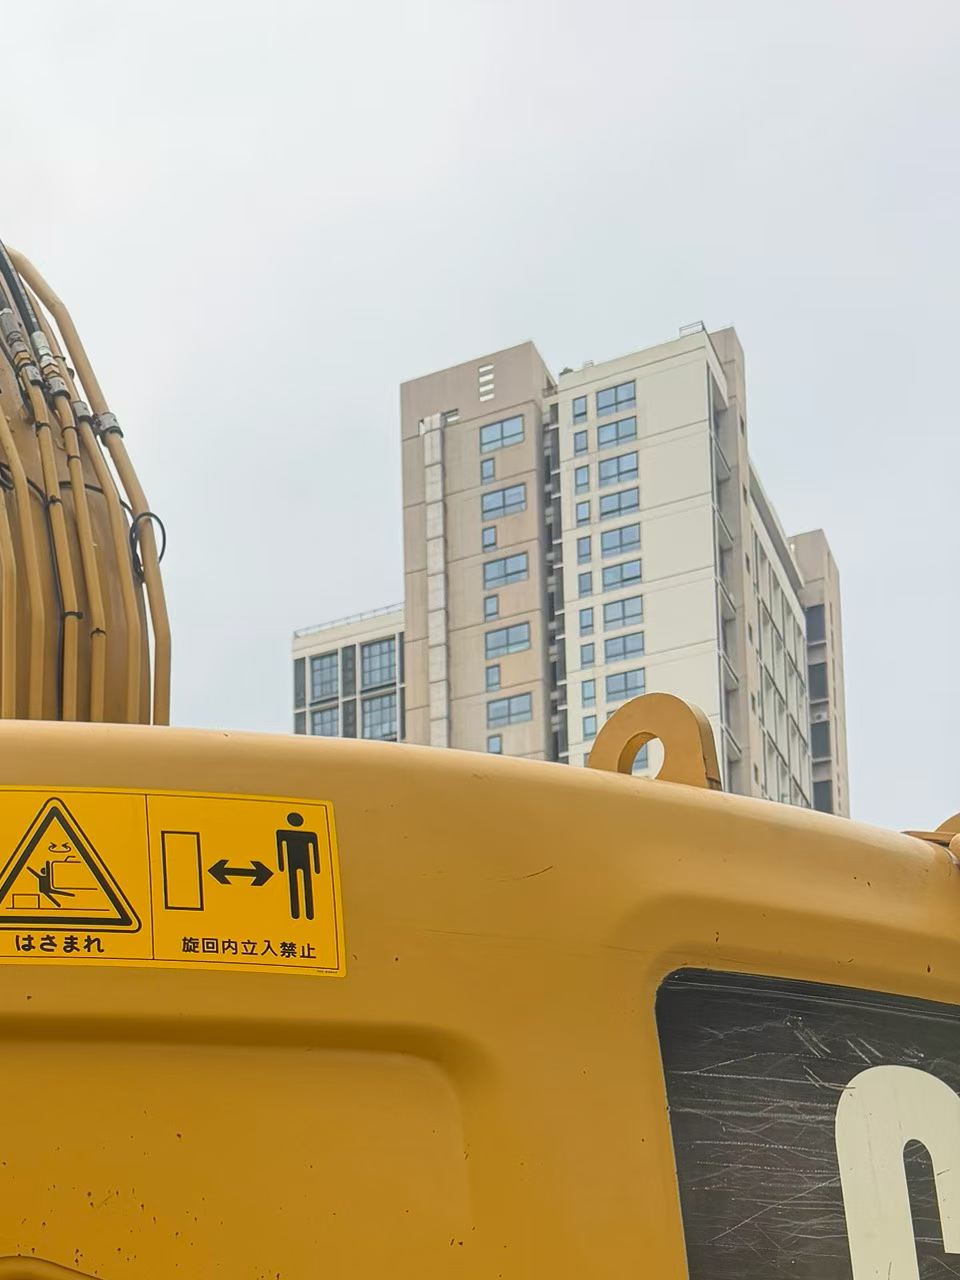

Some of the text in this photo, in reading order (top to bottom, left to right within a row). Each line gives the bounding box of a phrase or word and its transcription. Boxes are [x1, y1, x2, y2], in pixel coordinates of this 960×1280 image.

[15, 934, 105, 953] はさまれ
[181, 936, 317, 959] 旋回内立入禁止
